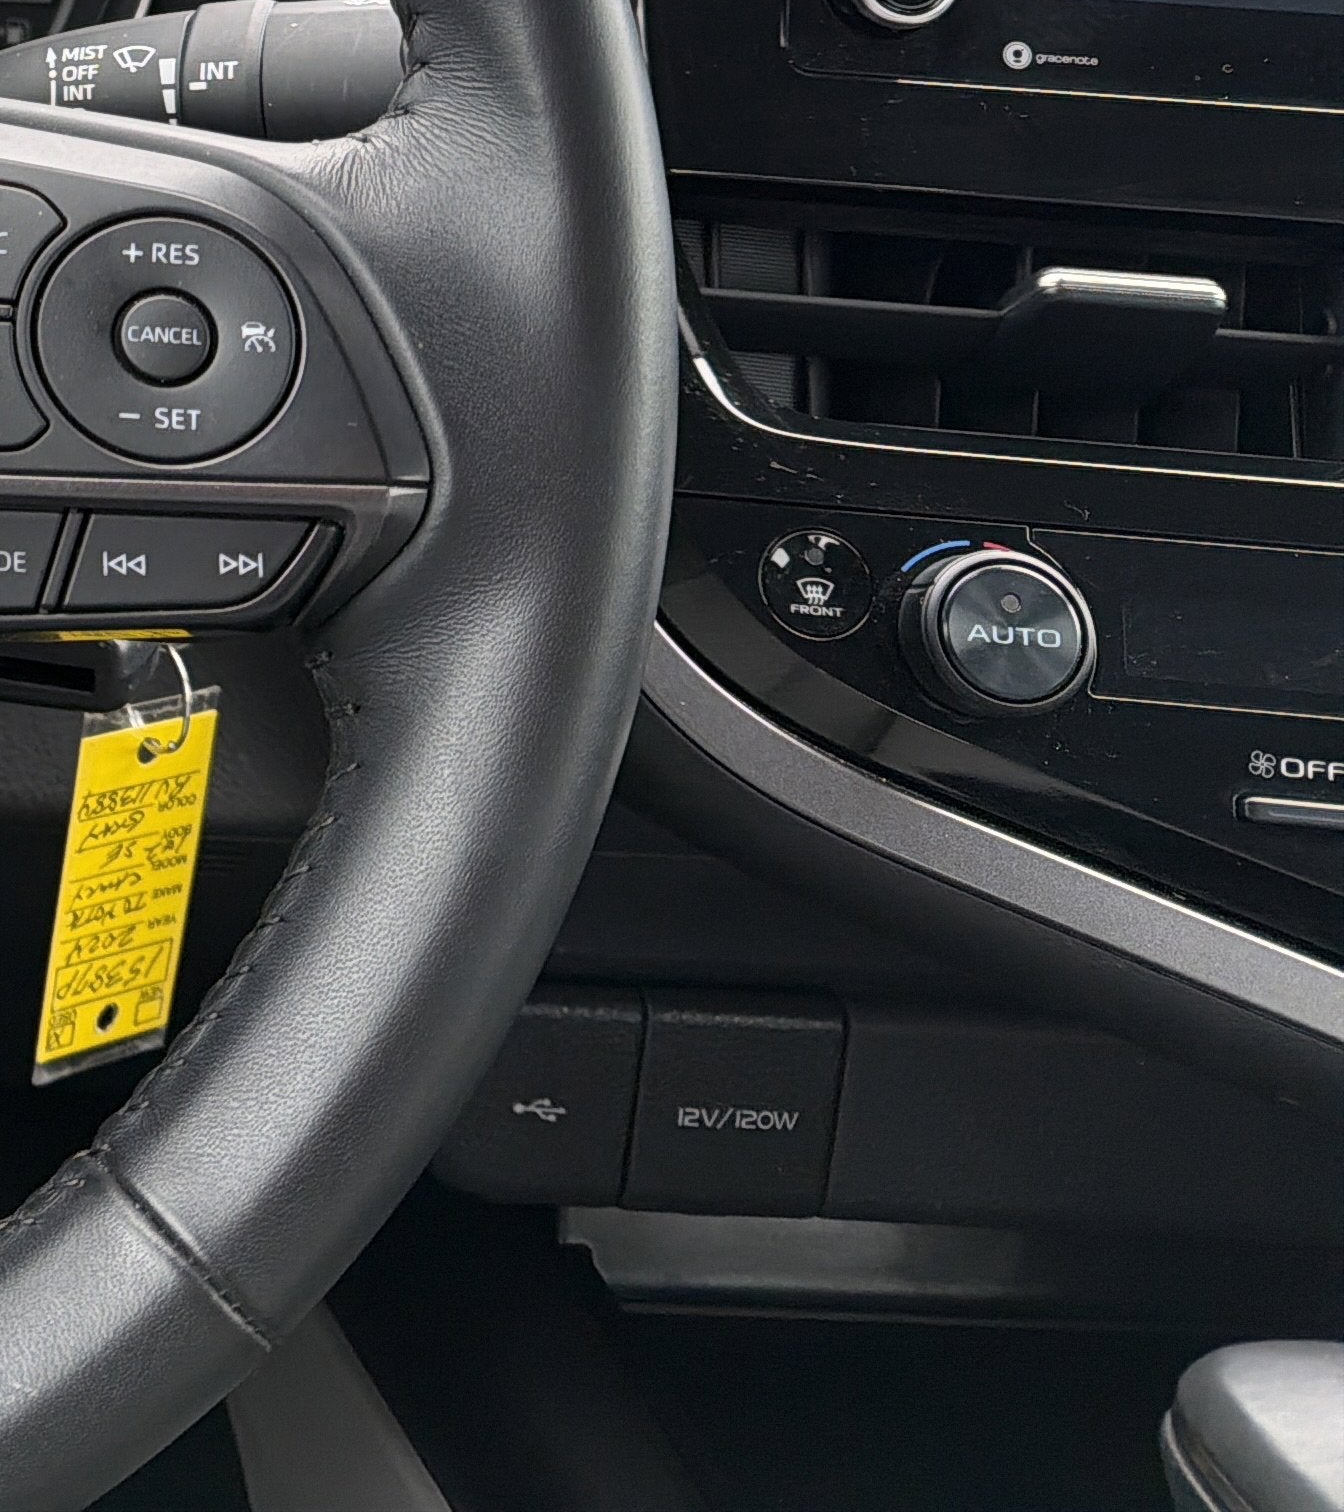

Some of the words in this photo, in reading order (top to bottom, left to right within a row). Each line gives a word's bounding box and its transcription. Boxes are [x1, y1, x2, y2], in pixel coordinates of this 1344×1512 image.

[61, 44, 108, 62] MIST
[1035, 53, 1100, 67] gracenote
[61, 64, 99, 82] OFF
[199, 60, 240, 81] INT
[62, 84, 94, 102] INT
[150, 244, 201, 266] RES
[126, 324, 203, 346] CANCEL
[154, 407, 202, 431] SET
[790, 603, 844, 618] FRONT
[966, 622, 1062, 649] AUTO
[1279, 757, 1344, 782] OFF
[158, 794, 197, 811] COLOR
[160, 823, 192, 840] BODY
[151, 854, 188, 872] MODEL
[151, 883, 184, 899] MAKE
[146, 913, 177, 929] YEAR
[677, 1106, 800, 1131] 12V/120W
